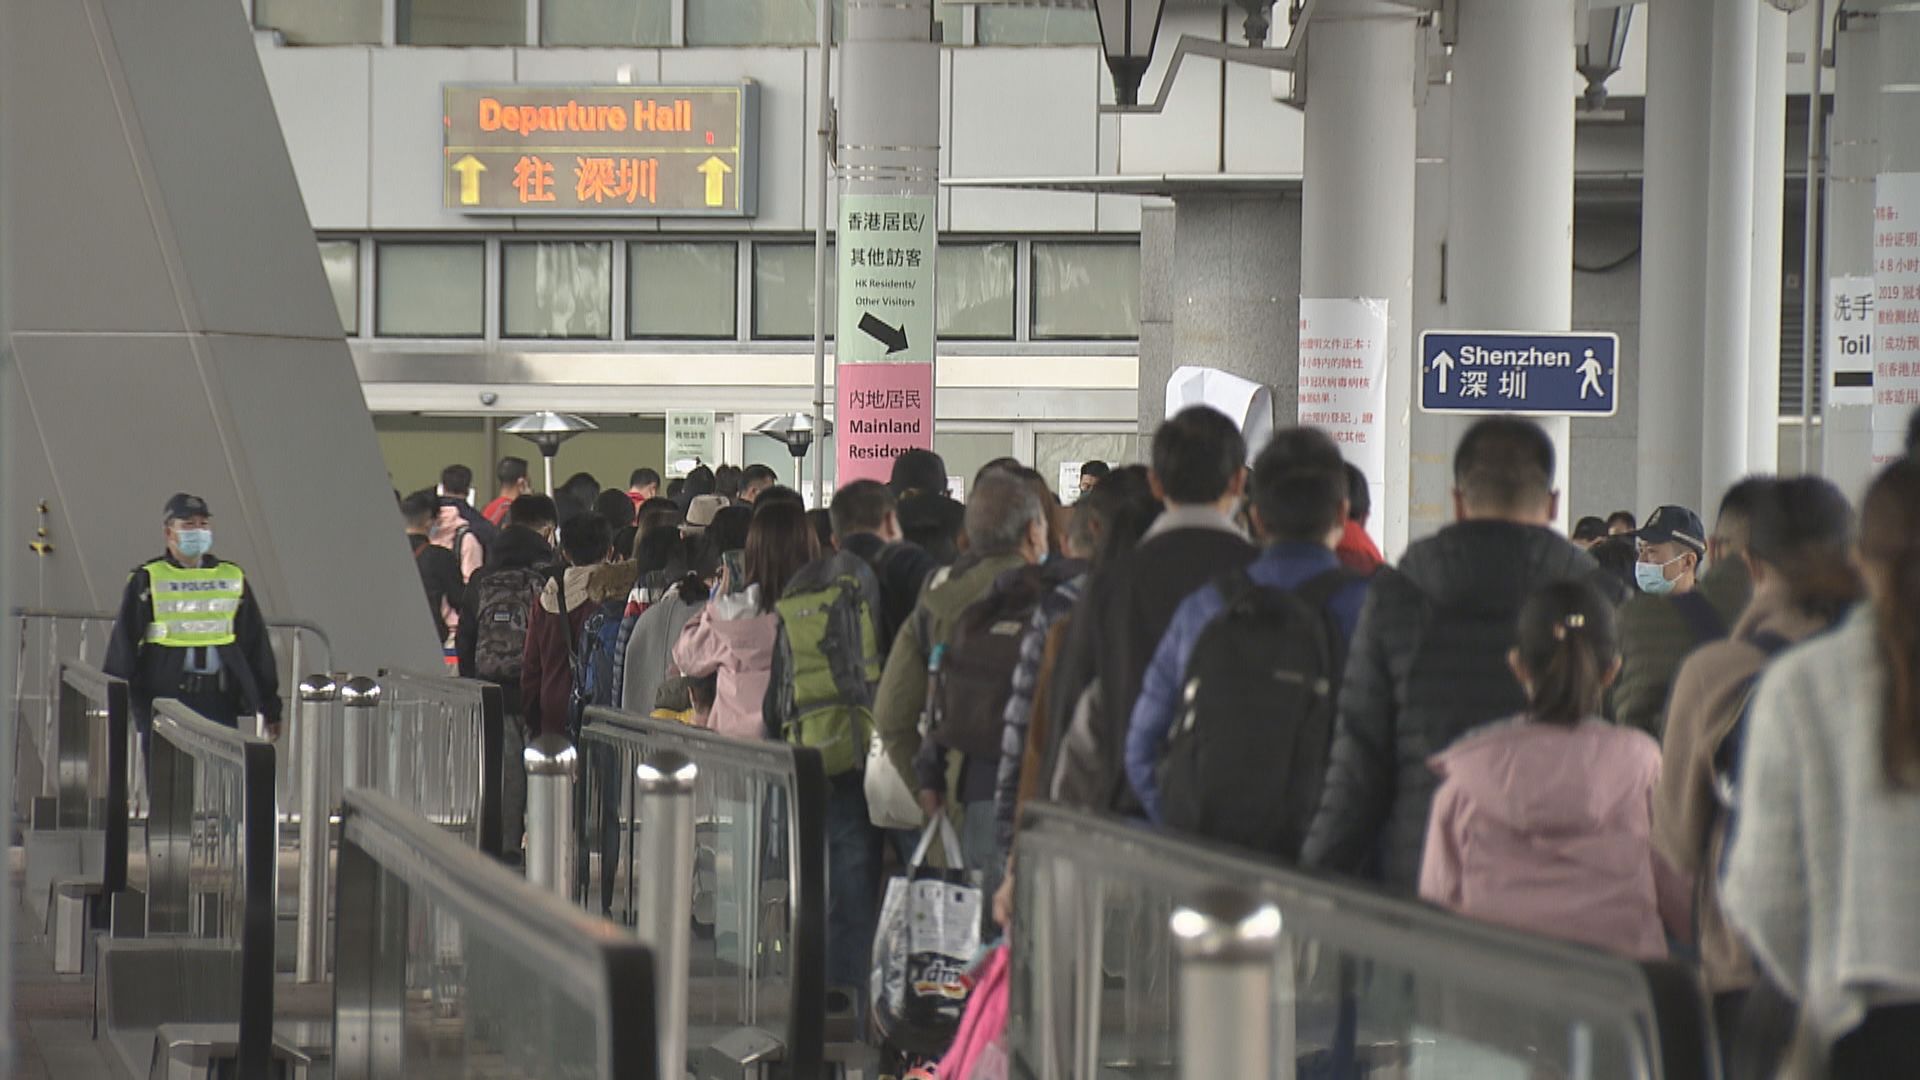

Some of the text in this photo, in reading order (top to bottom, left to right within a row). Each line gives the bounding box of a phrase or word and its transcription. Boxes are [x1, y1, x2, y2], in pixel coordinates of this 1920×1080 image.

[479, 98, 691, 136] Departure Hall
[512, 156, 659, 203] 往 深圳
[848, 212, 925, 233] 香港居民/
[850, 248, 922, 267] 其他訪客
[855, 279, 916, 290] HK Residents/
[855, 297, 915, 306] Other Visitors
[1834, 293, 1874, 321] 洗手
[1838, 334, 1870, 355] Toil
[1459, 345, 1571, 367] Shenzhen
[850, 418, 920, 433] Mainland
